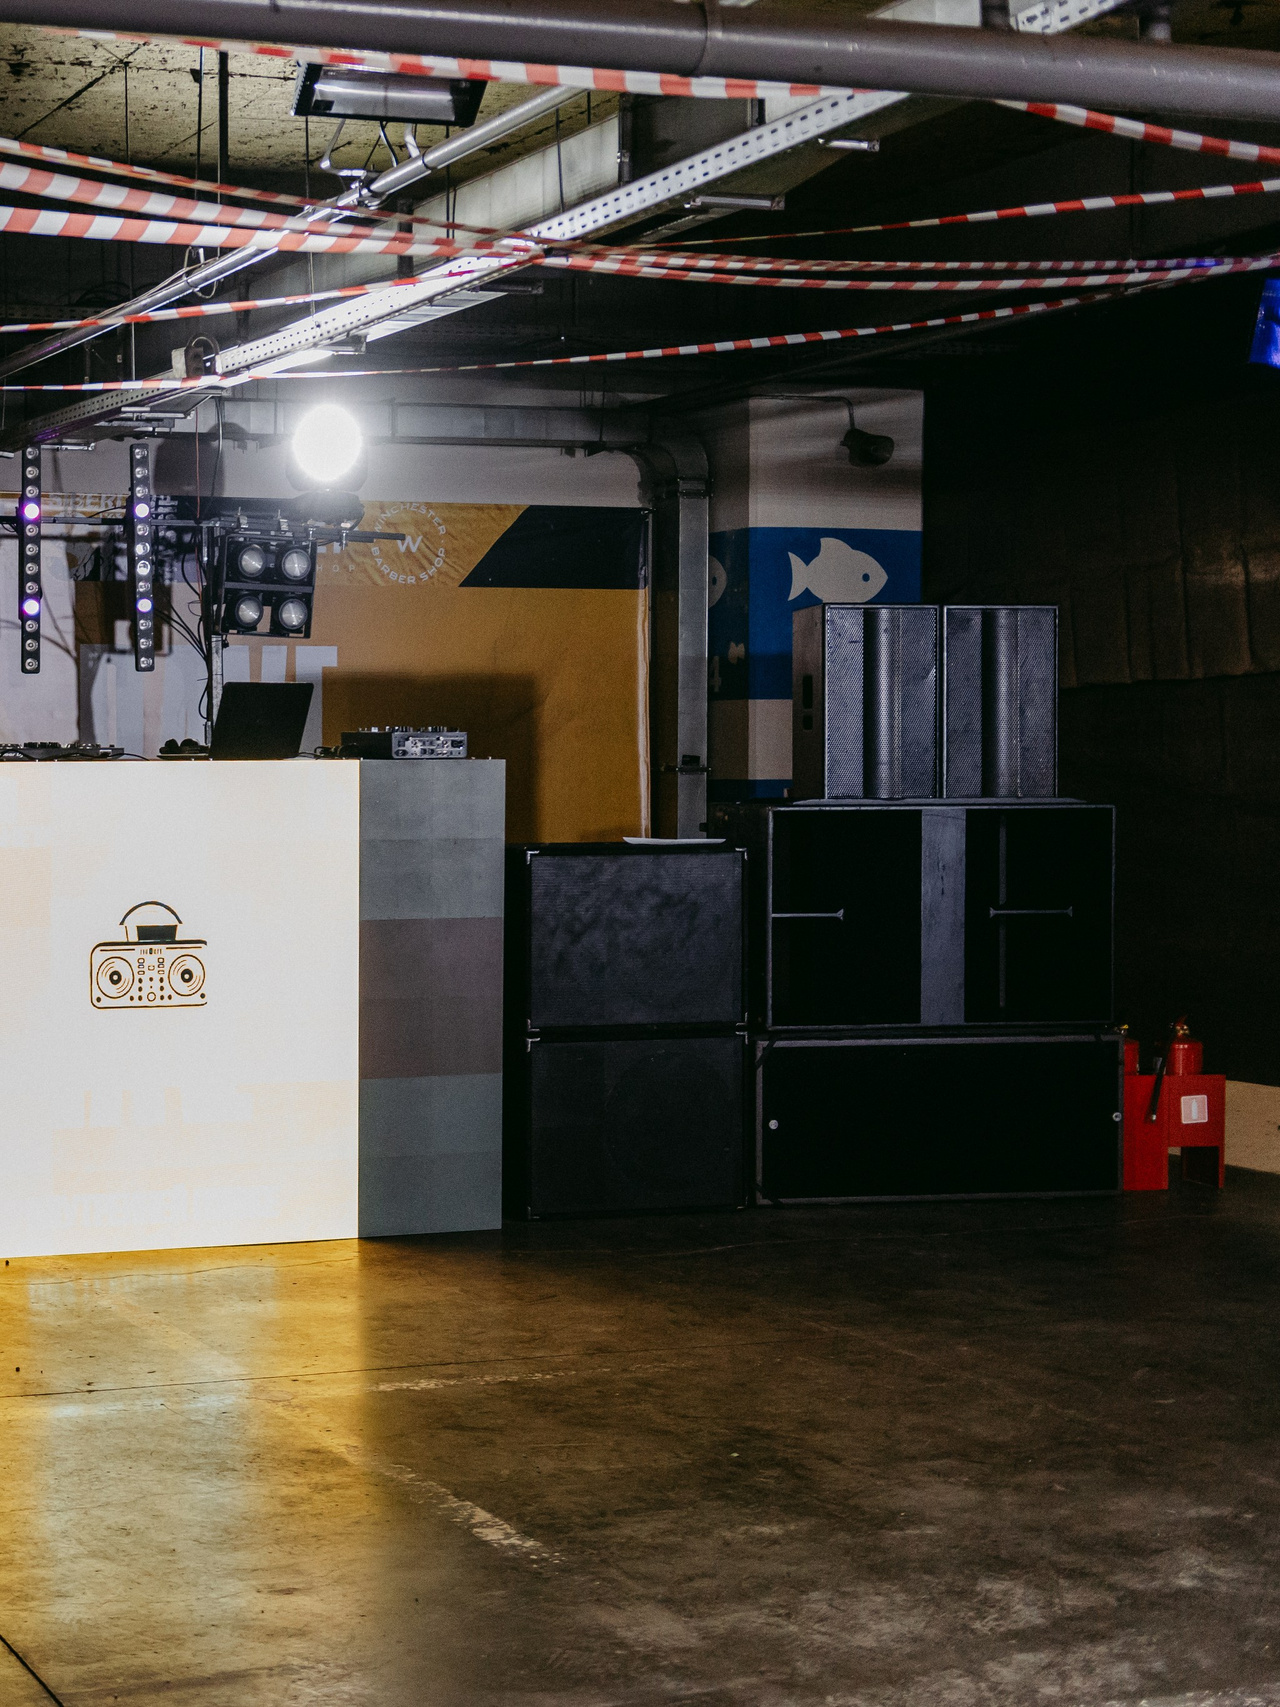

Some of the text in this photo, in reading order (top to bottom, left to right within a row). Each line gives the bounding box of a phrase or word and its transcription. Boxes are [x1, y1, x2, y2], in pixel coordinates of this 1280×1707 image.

[397, 535, 423, 553] W
[317, 564, 356, 573] HOP
[371, 546, 446, 585] BARBER SHOP
